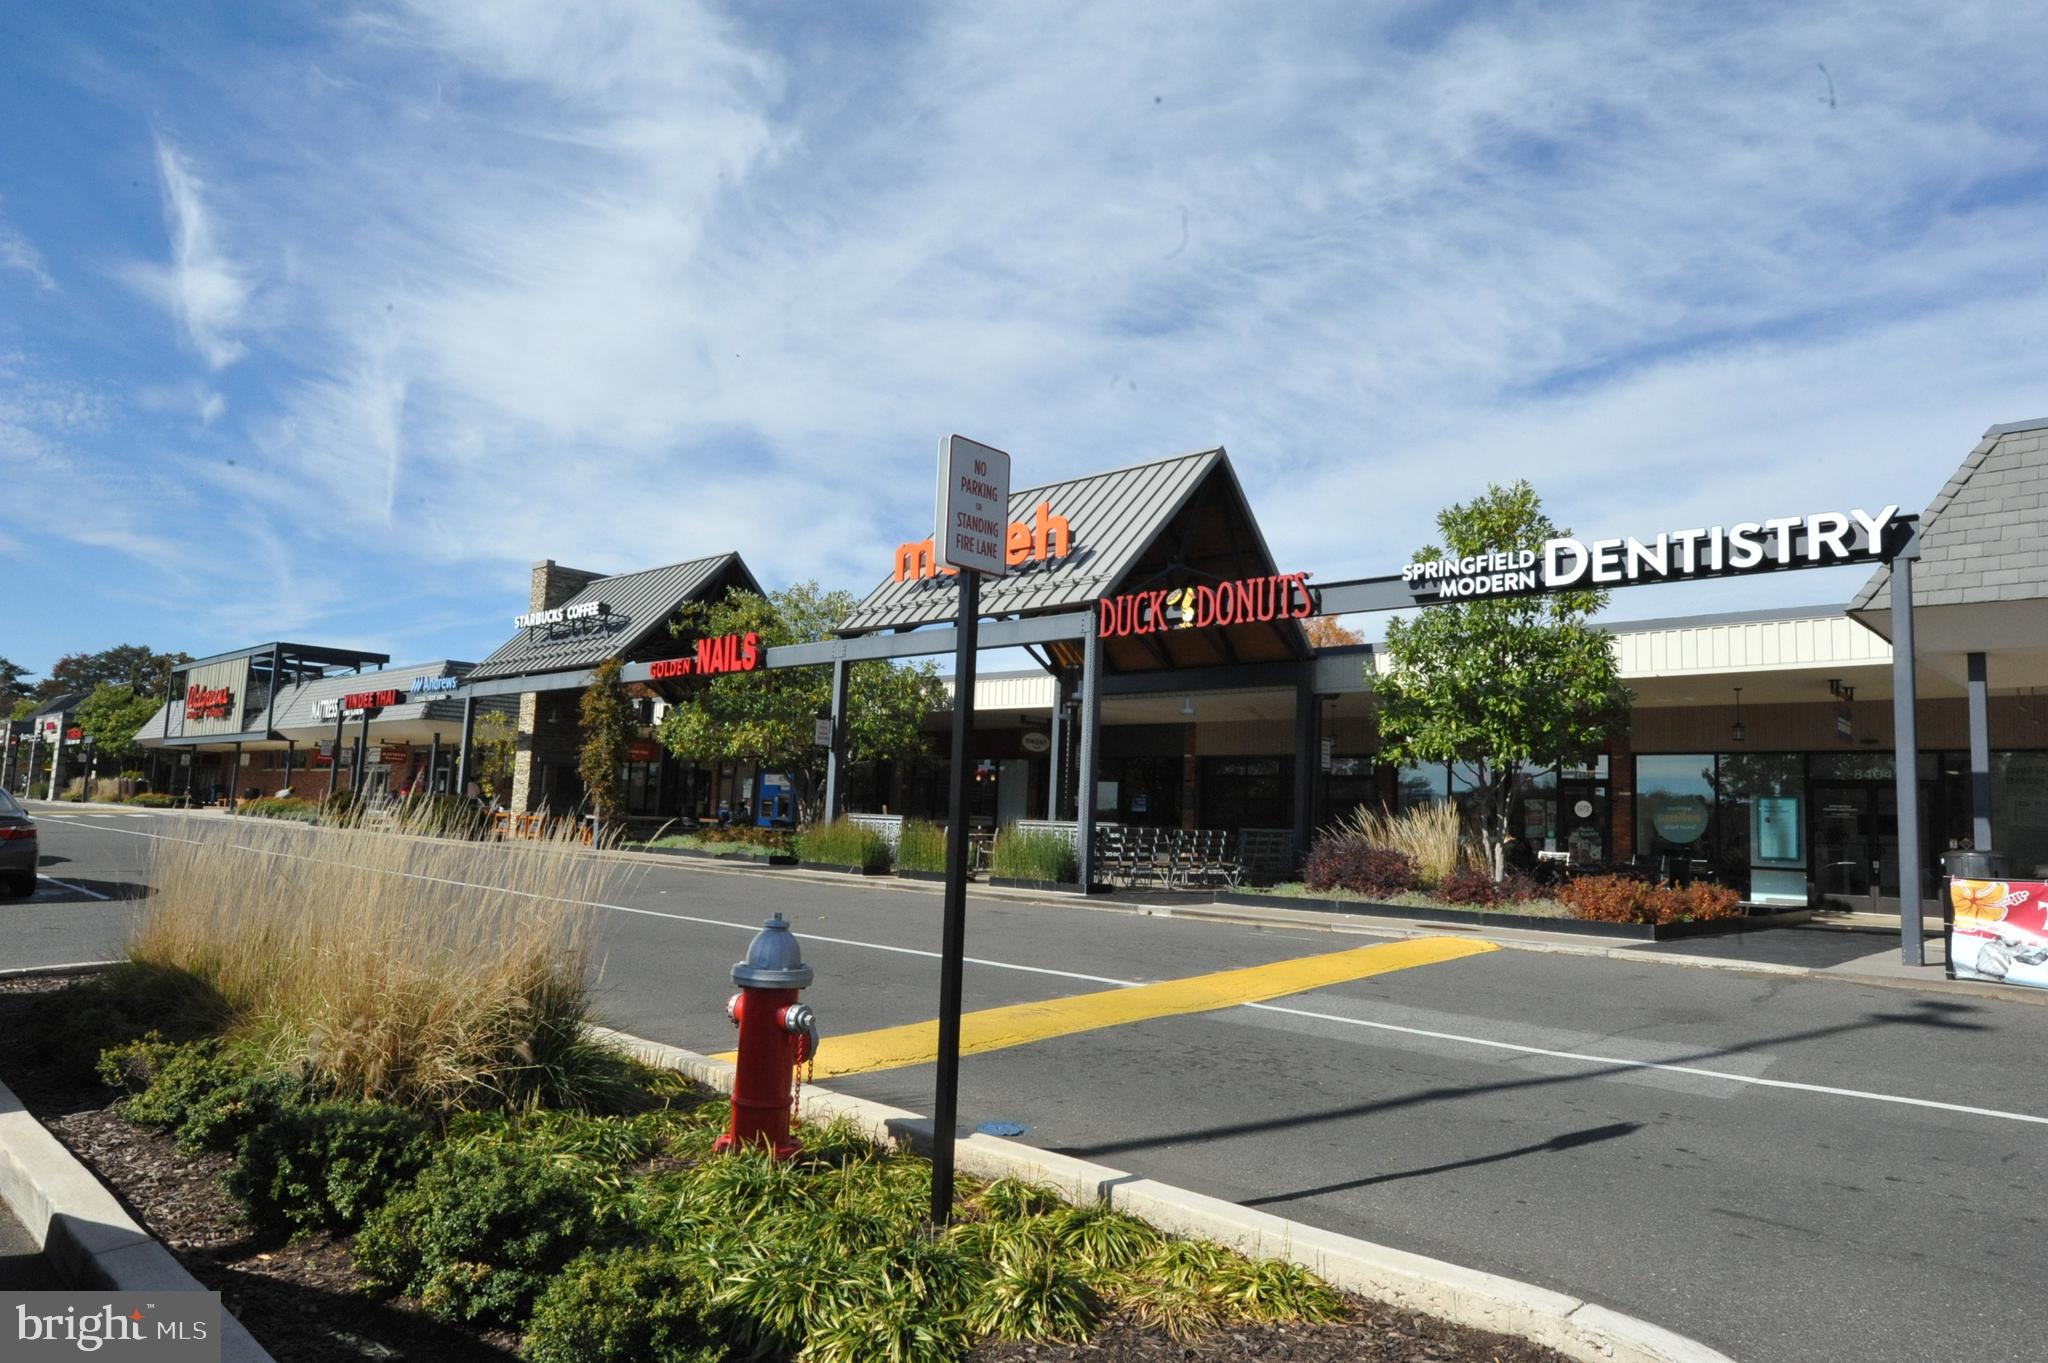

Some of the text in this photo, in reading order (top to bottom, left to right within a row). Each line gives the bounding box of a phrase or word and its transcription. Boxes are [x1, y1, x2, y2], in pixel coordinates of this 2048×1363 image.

[974, 459, 987, 477] NO
[960, 476, 998, 502] PARKING
[957, 511, 999, 538] STANDING
[895, 501, 1072, 582] meh
[956, 533, 998, 559] FIRE LANE
[1544, 504, 1899, 588] DENTISTRY
[1401, 549, 1536, 582] SPRINGFIELD
[1439, 570, 1536, 598] MODERN
[514, 601, 600, 629] STARBUCKS COFFEE
[1099, 572, 1313, 638] DUCK DONUTS
[649, 630, 759, 679] GOLDEN NAILS
[423, 676, 457, 691] Andrews
[311, 698, 338, 719] MATTRESS
[376, 689, 397, 708] THAI
